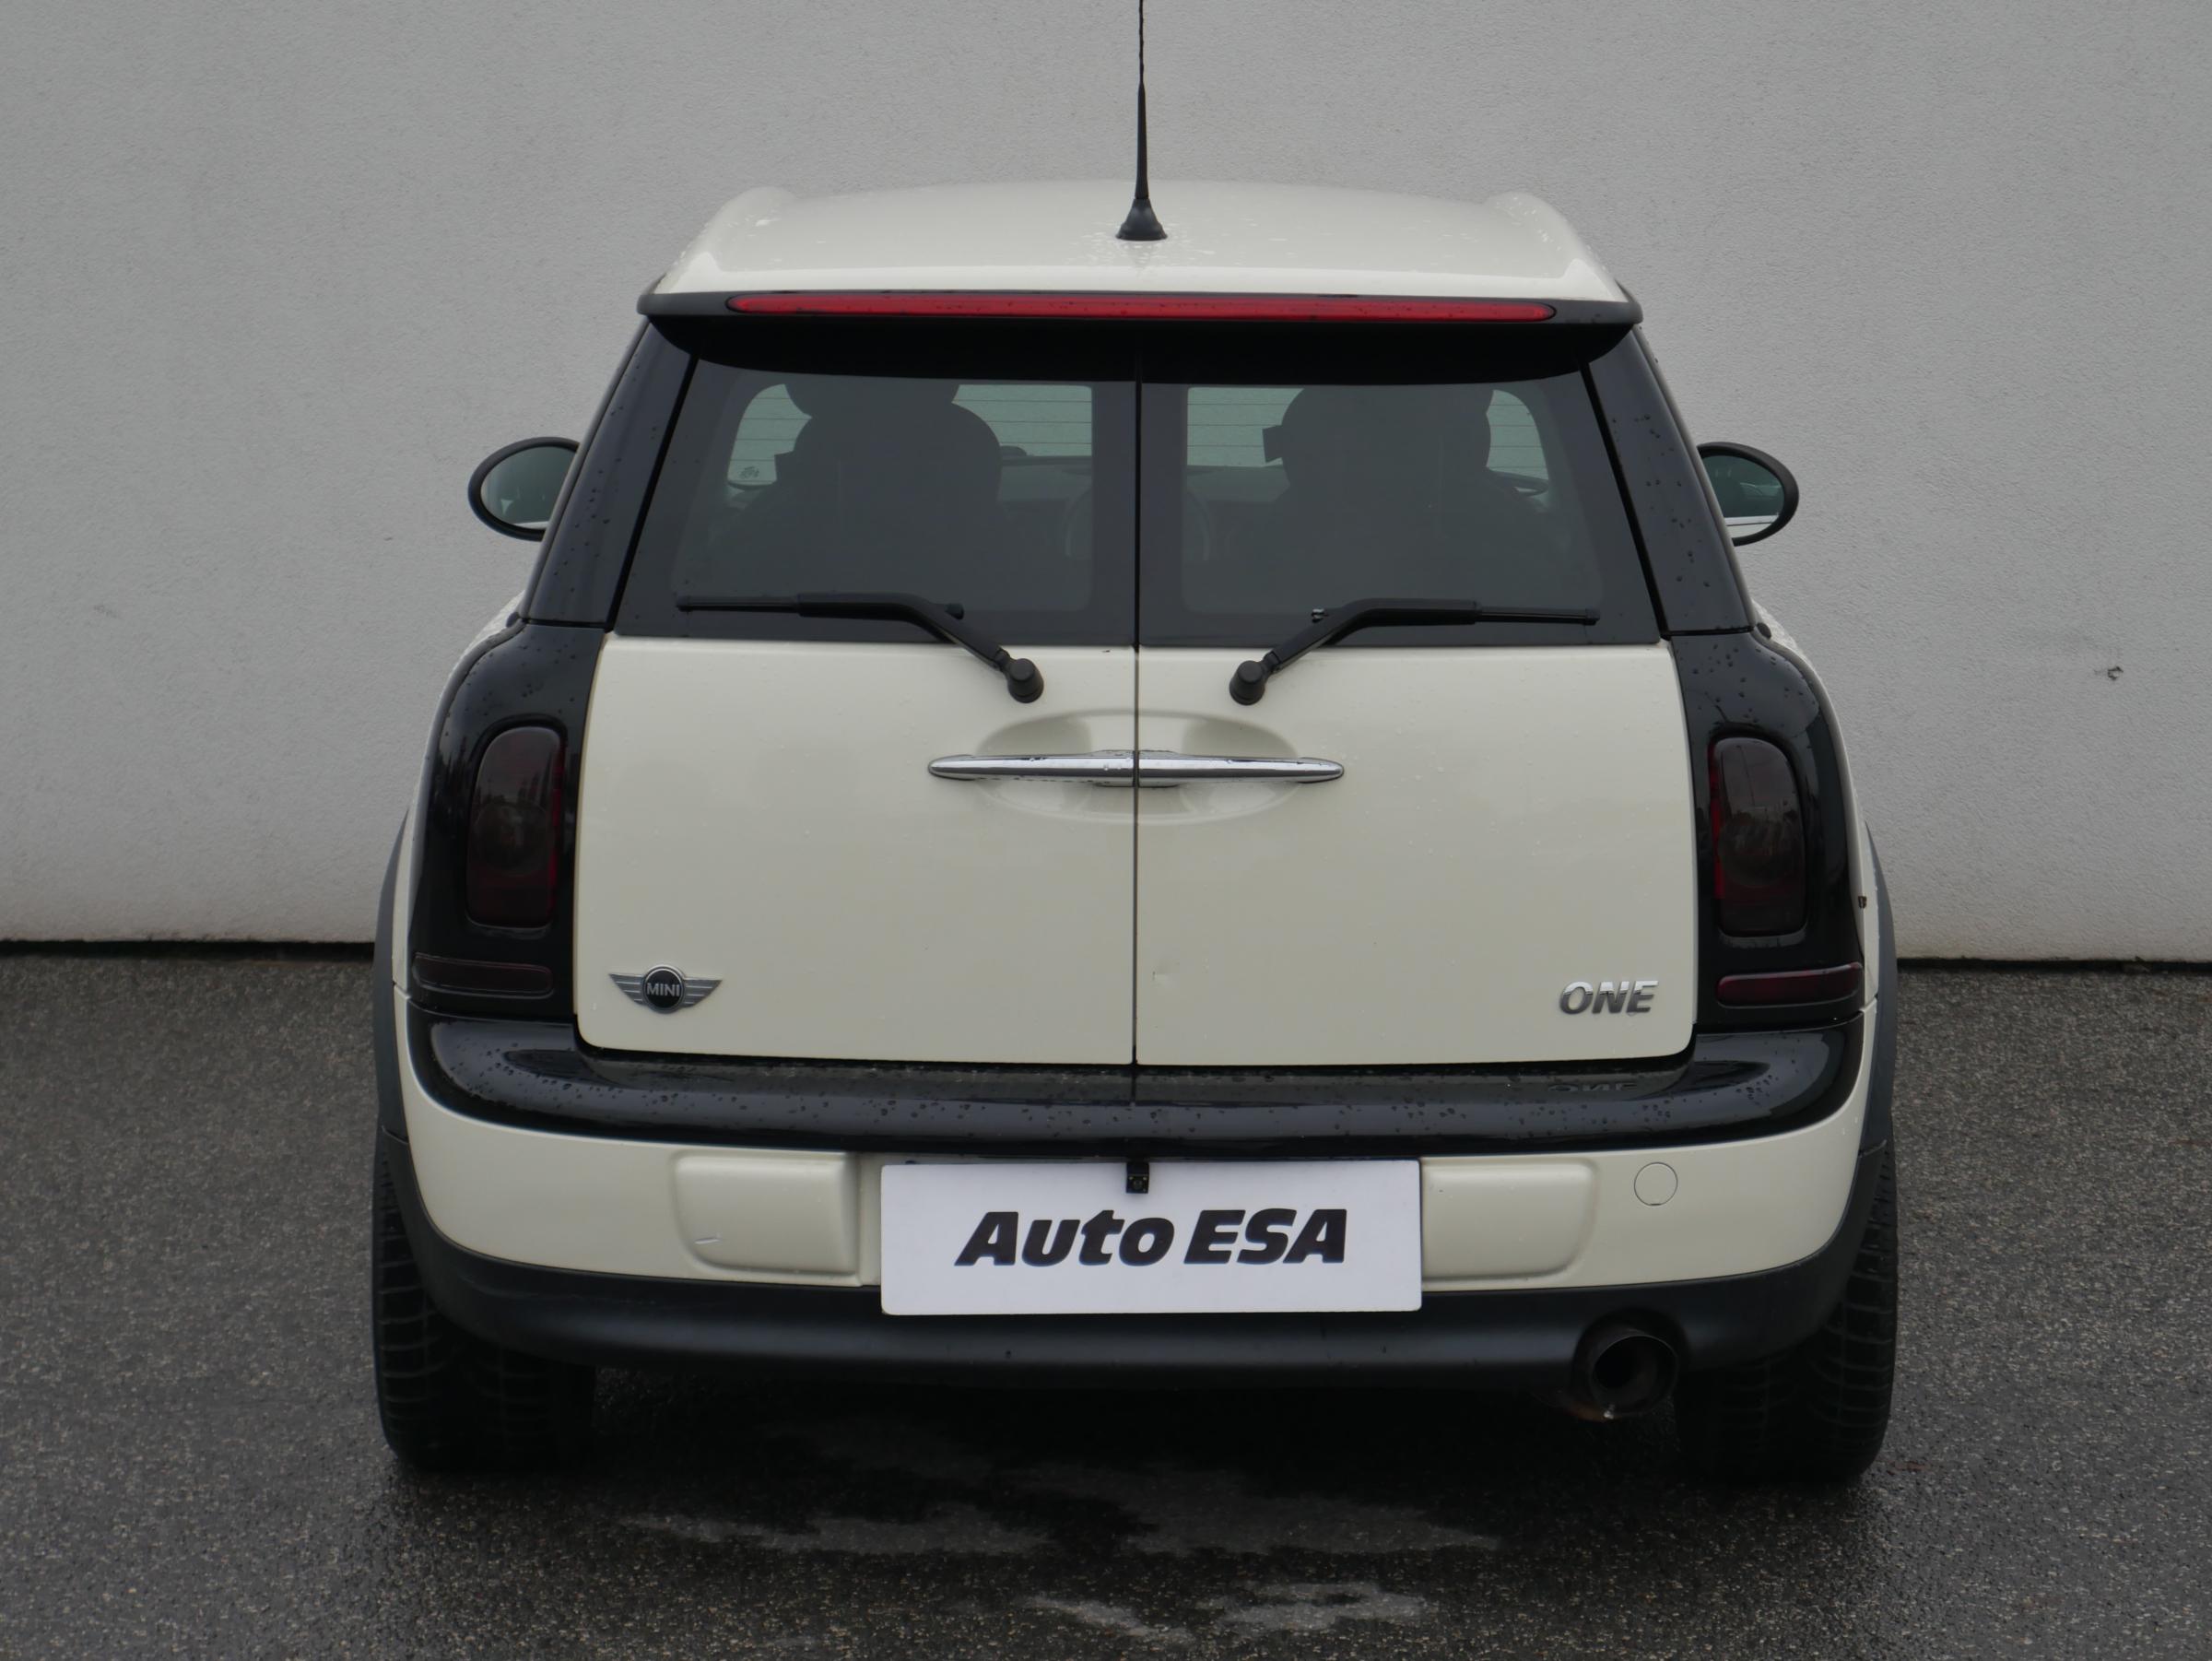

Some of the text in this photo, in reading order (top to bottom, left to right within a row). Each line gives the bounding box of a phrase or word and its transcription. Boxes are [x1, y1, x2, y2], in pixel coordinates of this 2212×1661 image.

[647, 983, 680, 996] MINI
[1559, 981, 1659, 1015] ONE
[954, 1207, 1347, 1267] Auto ESA
